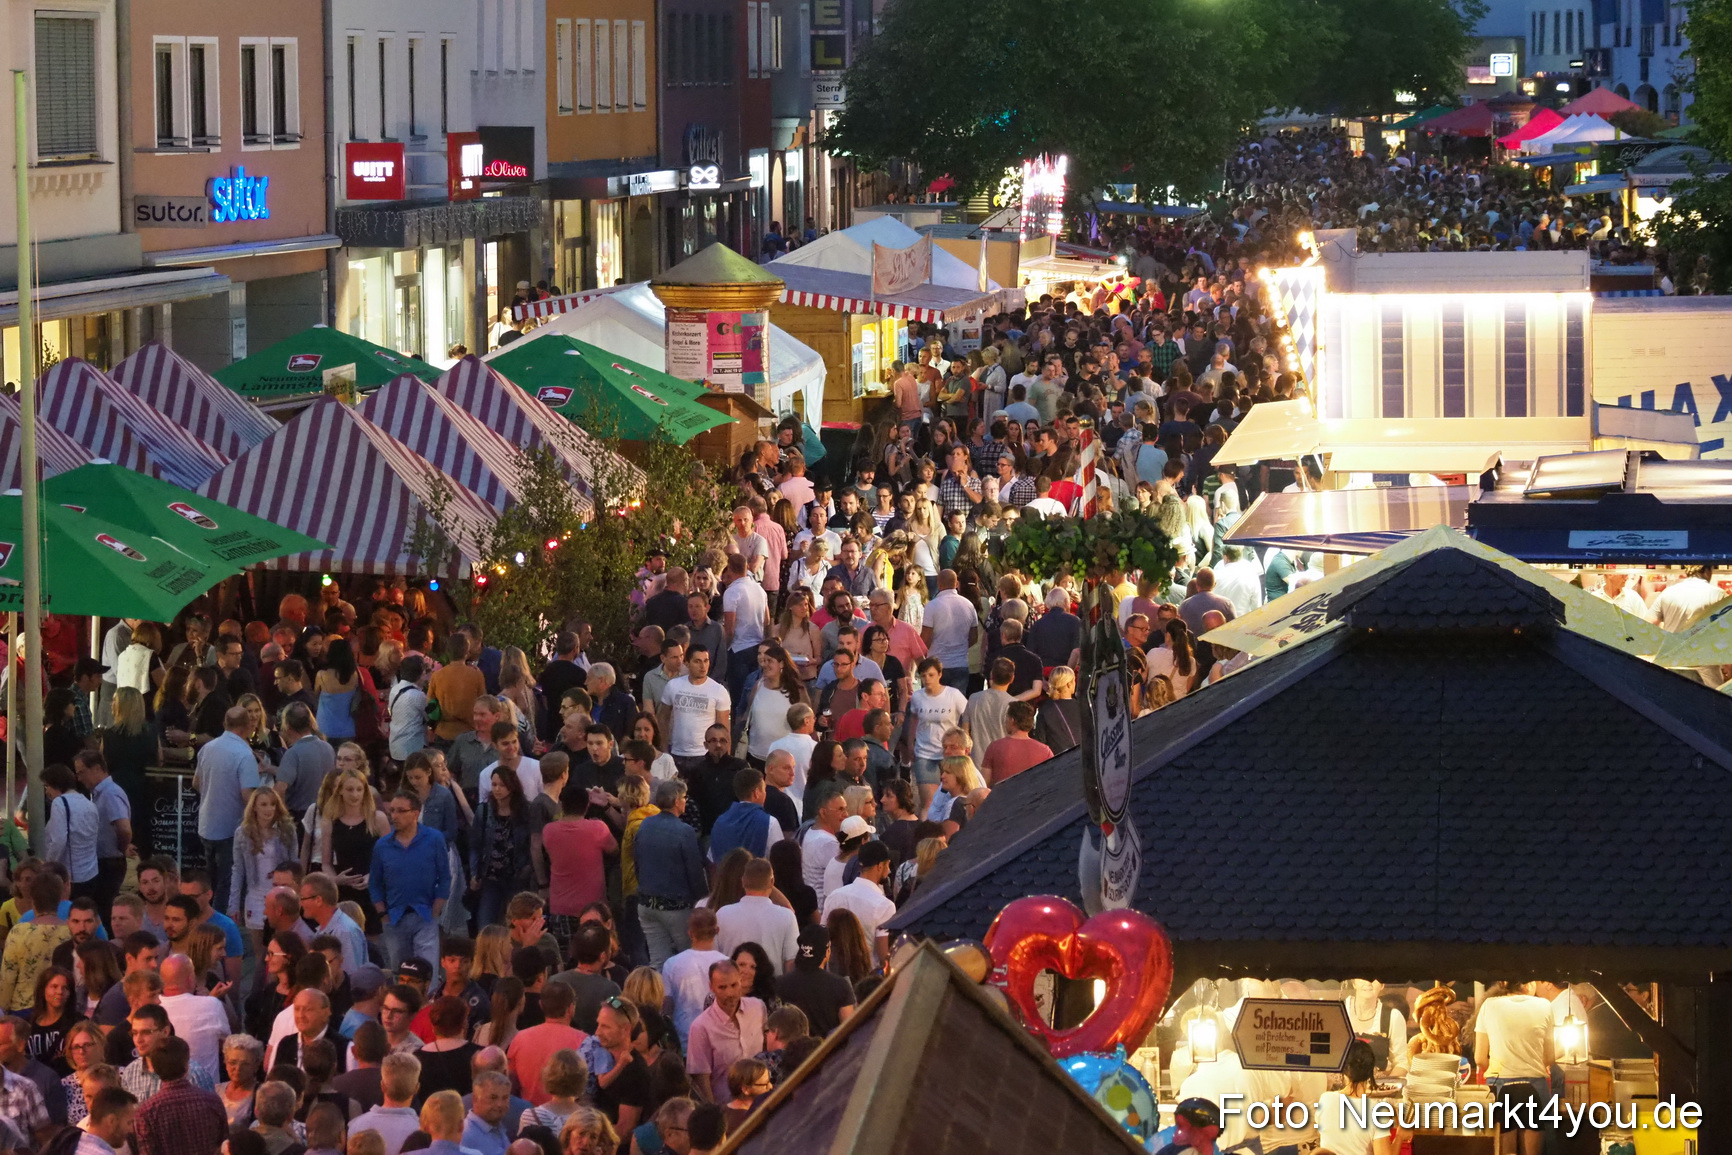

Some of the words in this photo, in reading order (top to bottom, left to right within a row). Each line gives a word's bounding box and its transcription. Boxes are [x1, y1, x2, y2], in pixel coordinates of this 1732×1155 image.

[816, 84, 840, 93] Stern
[353, 161, 394, 177] WITT
[484, 160, 528, 177] s.Oliver
[1253, 1008, 1324, 1031] Schaschlik
[1266, 1042, 1294, 1053] Pommes
